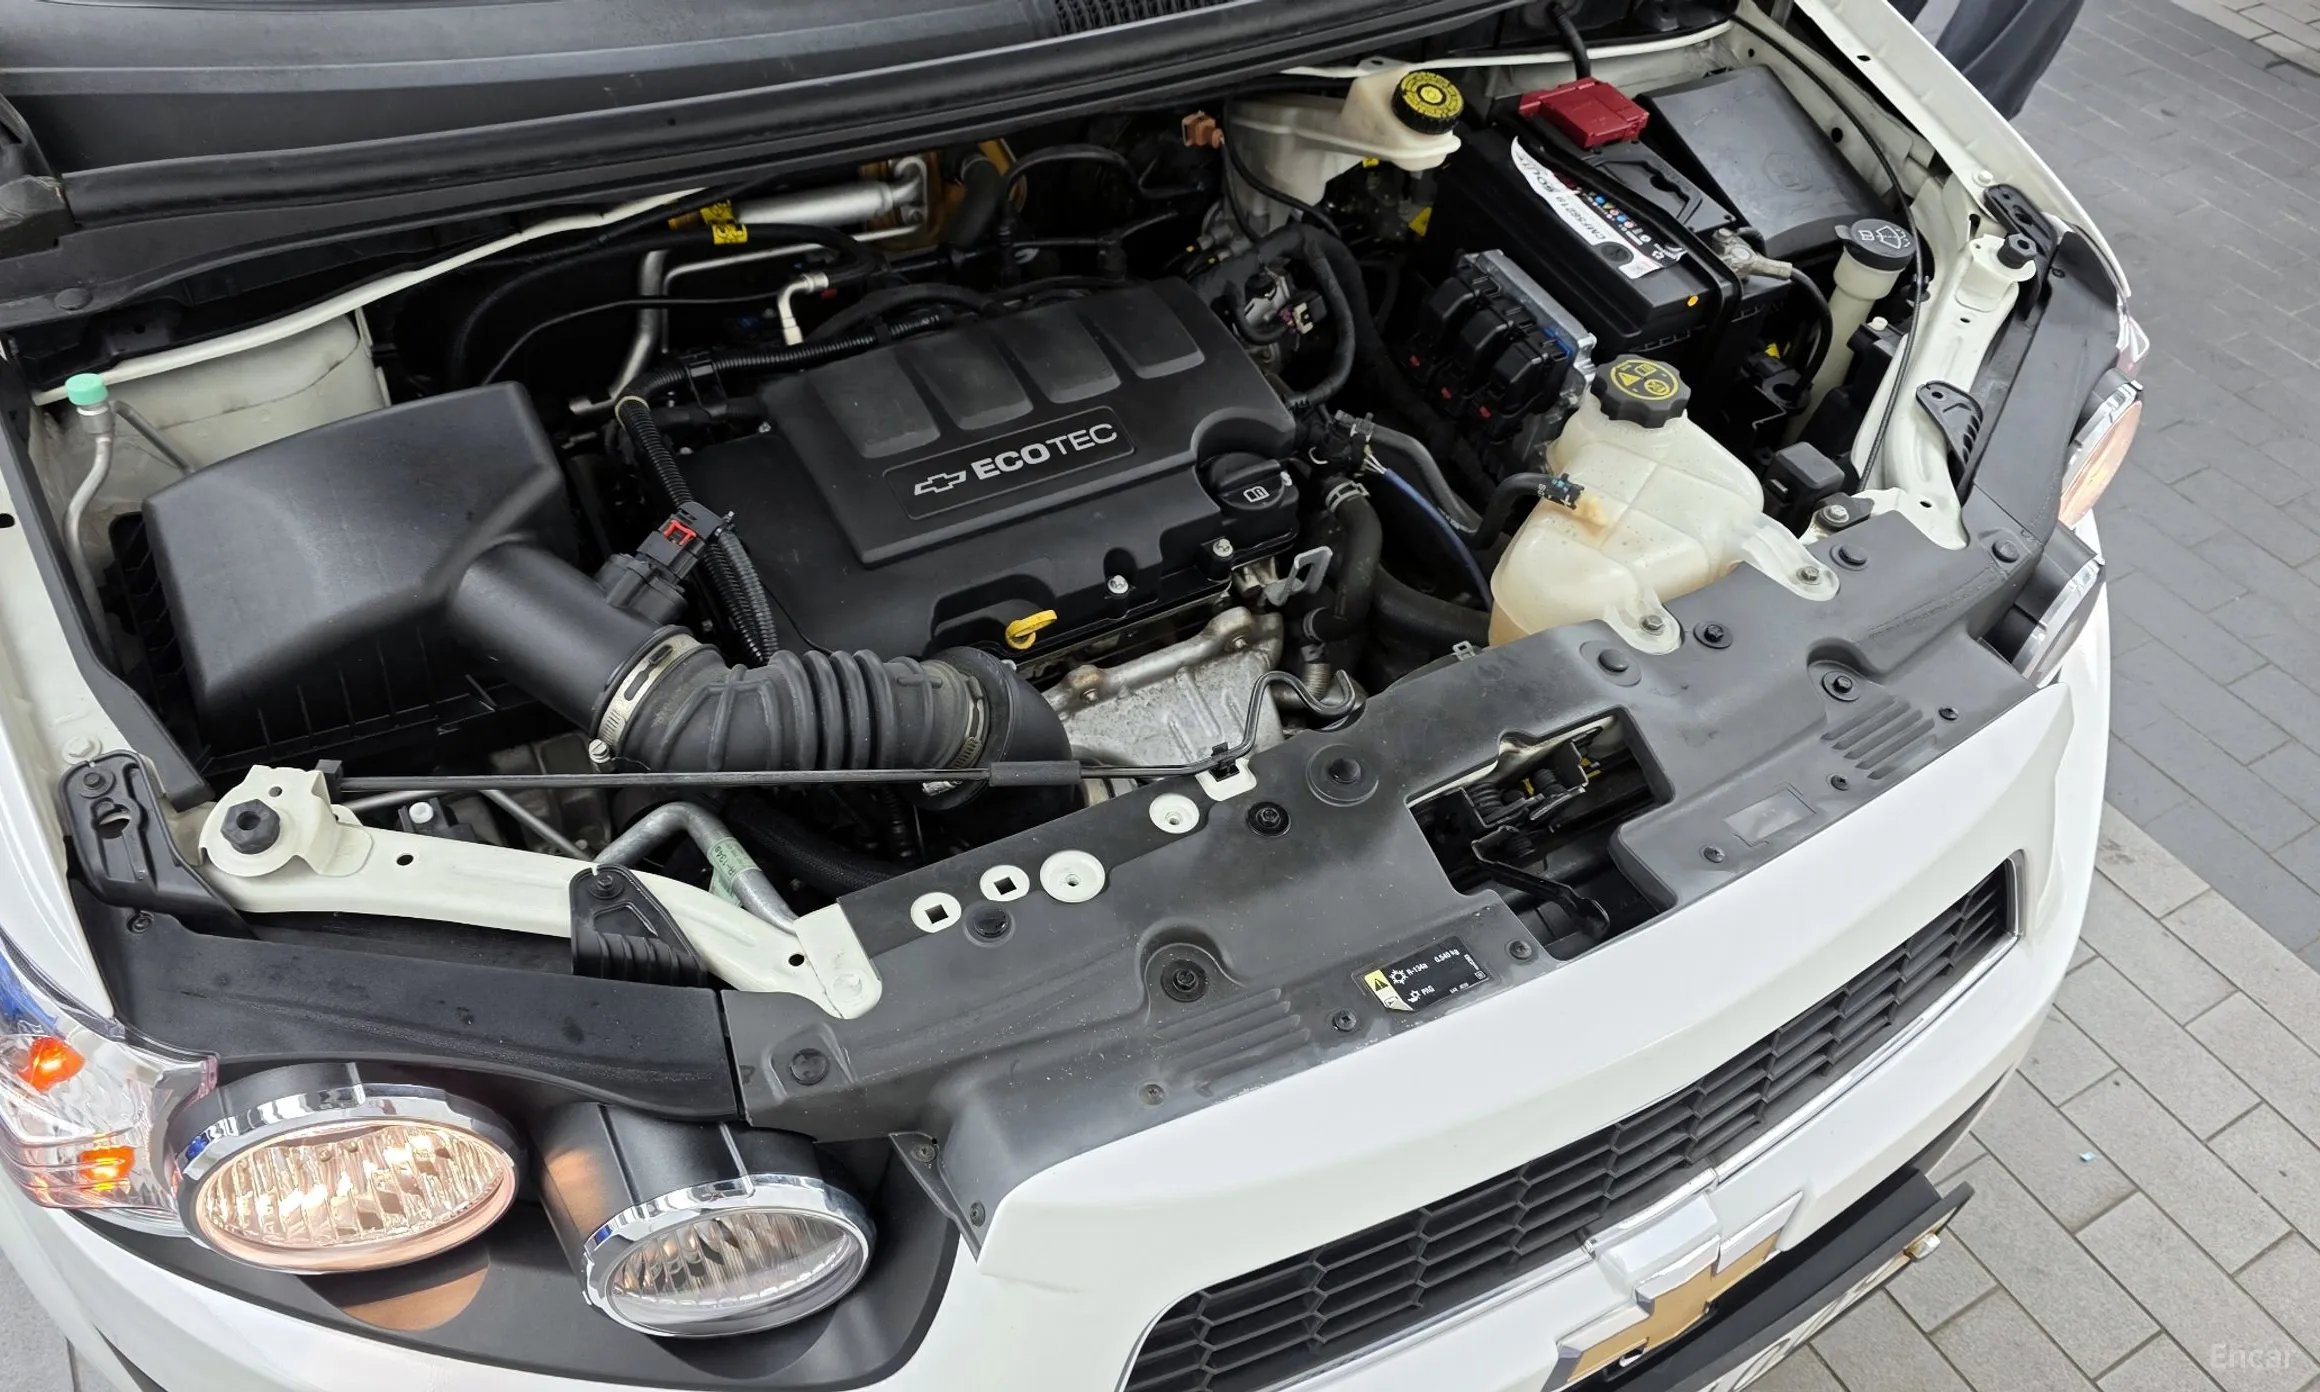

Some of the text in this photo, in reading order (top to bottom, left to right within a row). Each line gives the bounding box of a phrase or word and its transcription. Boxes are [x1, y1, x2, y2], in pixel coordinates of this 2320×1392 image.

[971, 423, 1118, 480] ECOTEC
[713, 845, 735, 877] R-134a
[1406, 962, 1429, 976] R-134a
